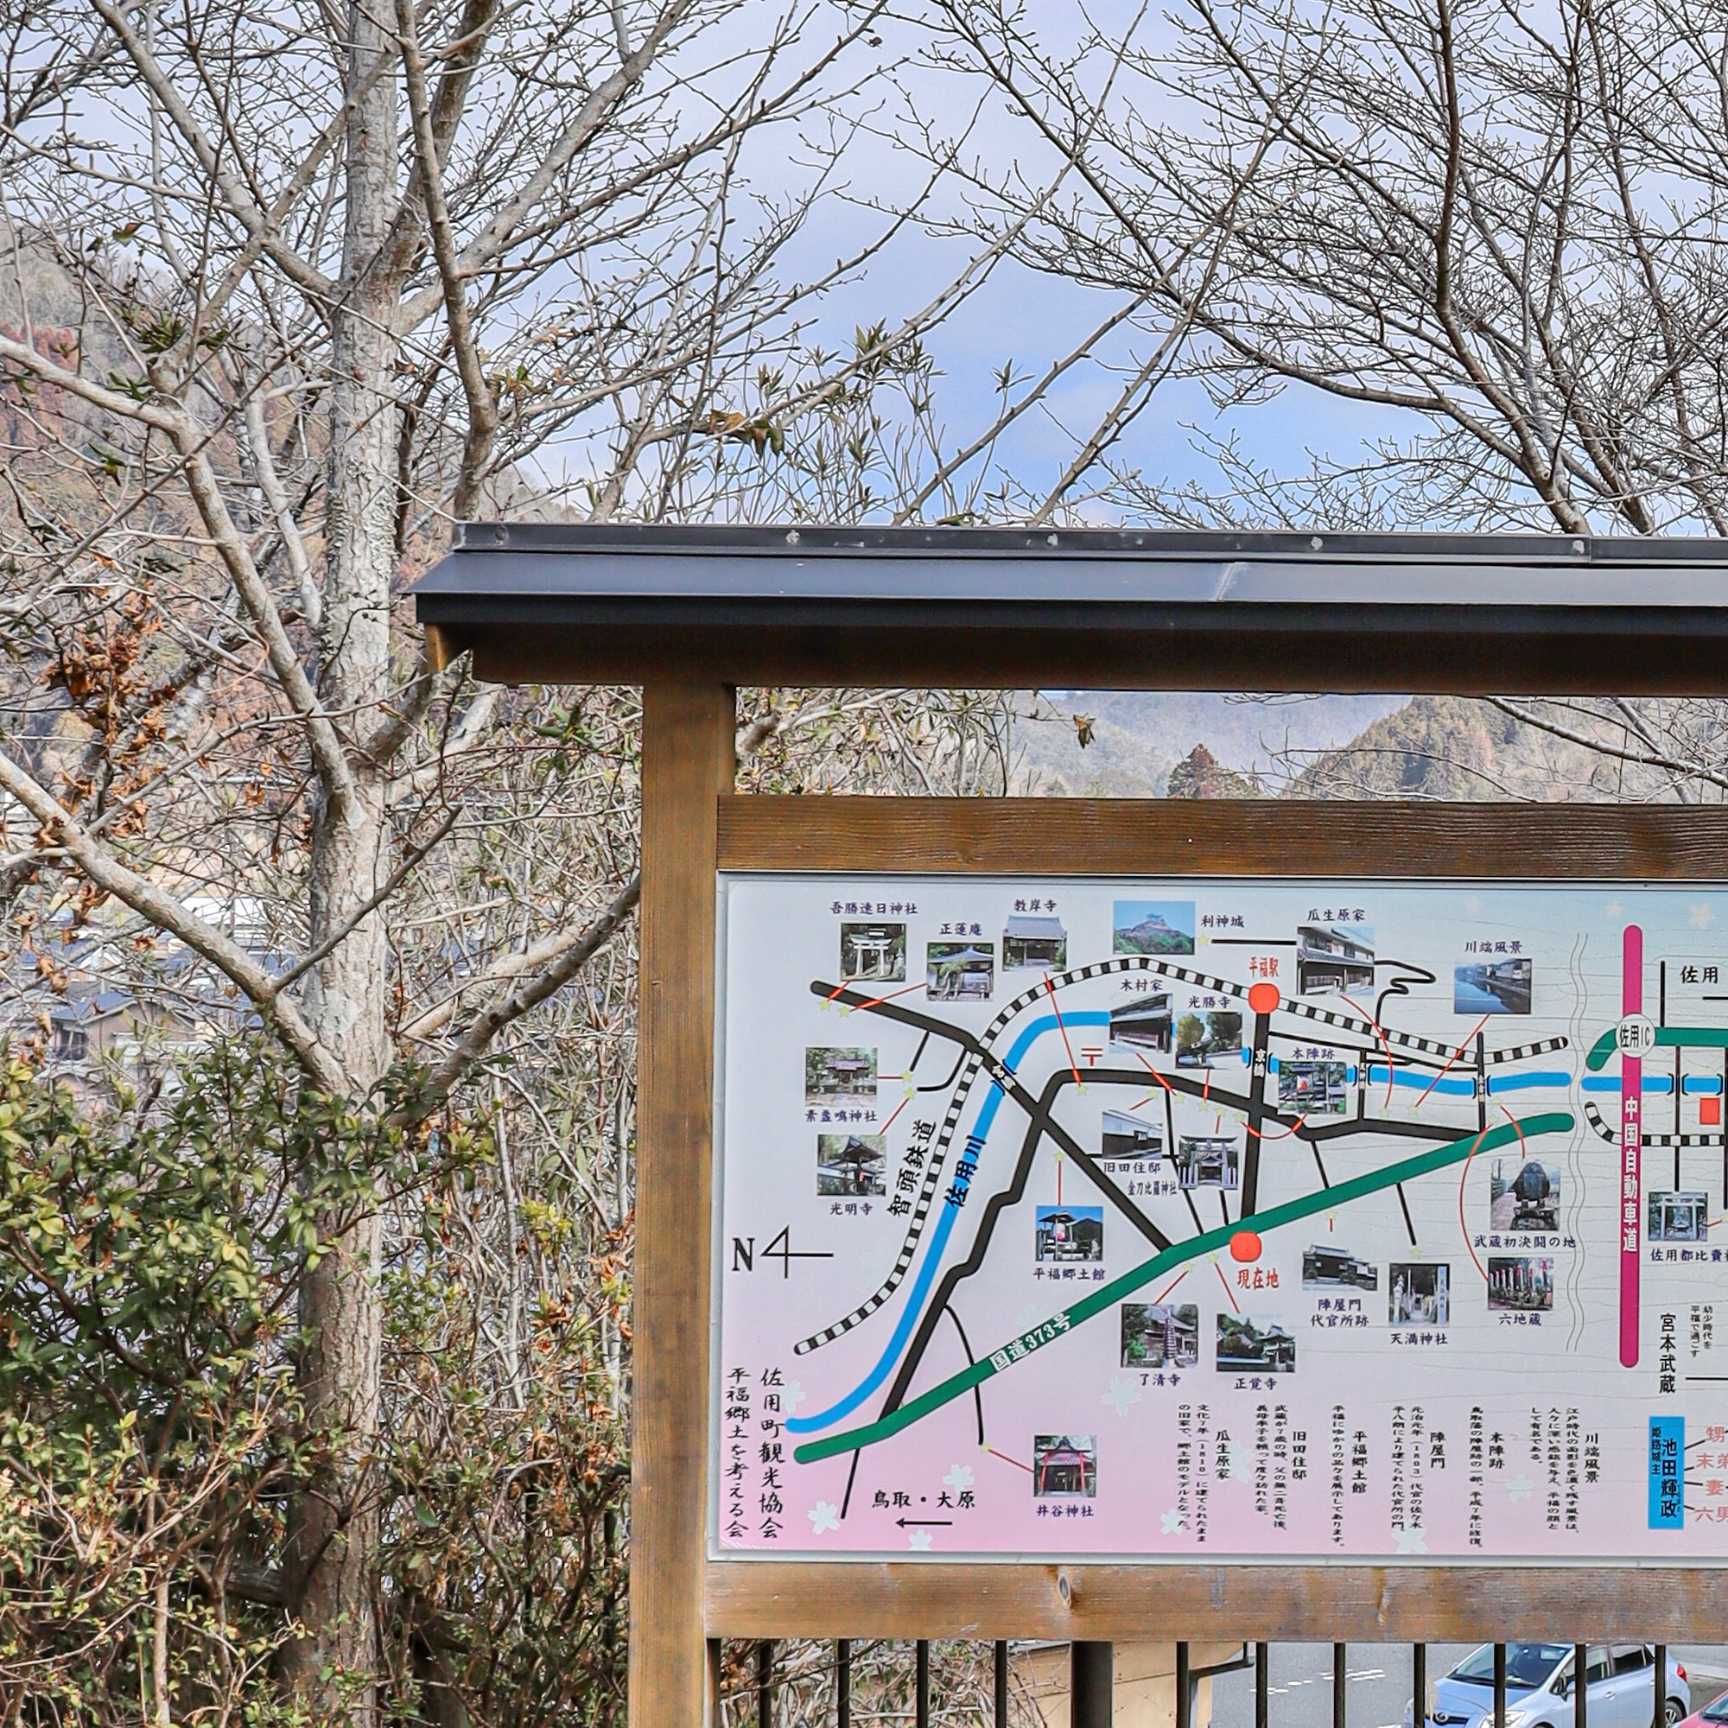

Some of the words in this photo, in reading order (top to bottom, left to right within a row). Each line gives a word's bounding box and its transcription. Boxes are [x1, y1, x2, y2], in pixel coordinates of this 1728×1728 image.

[1200, 914, 1246, 929] 利神城
[1307, 907, 1366, 923] 瓜生原家
[1464, 939, 1523, 955] 川端風景
[1120, 978, 1164, 993] 木村家
[1619, 1026, 1651, 1049] 佐用IC
[1291, 1046, 1335, 1061] 本陣跡
[886, 1119, 937, 1217] 智頭鉄道
[943, 1135, 987, 1208] 佐用川
[1103, 1161, 1162, 1175] 旧田住邸
[1622, 1095, 1639, 1253] 中国自動車道
[829, 1202, 874, 1216] 光明寺
[1474, 1235, 1577, 1249] 武蔵初決闘の地
[731, 1237, 756, 1272] N
[1033, 1267, 1107, 1281] 平福郷土館
[1237, 1267, 1280, 1291] 現在地
[1317, 1298, 1362, 1312] 陣屋門
[1310, 1314, 1370, 1328] 代官所跡
[1498, 1313, 1542, 1327] 六地蔵
[989, 1311, 1072, 1373] 国道373号
[1390, 1332, 1449, 1346] 天満神社
[1659, 1312, 1676, 1394] 宮本武蔵
[724, 1366, 751, 1539] 平福郷土を考える会
[758, 1366, 786, 1539] 佐用町観光協会
[1215, 1429, 1231, 1480] 瓜生原家
[1292, 1430, 1307, 1480] 旧田住邸
[1430, 1431, 1446, 1469] 陣屋門
[1488, 1432, 1505, 1470] 本陣跡
[1584, 1432, 1600, 1484] 川端風景
[1351, 1430, 1368, 1494] 平福郷土館
[1660, 1438, 1679, 1519] 池田輝政
[1706, 1479, 1725, 1496] 妻
[872, 1489, 976, 1509] 鳥取・大原
[1036, 1504, 1095, 1519] 井谷神社
